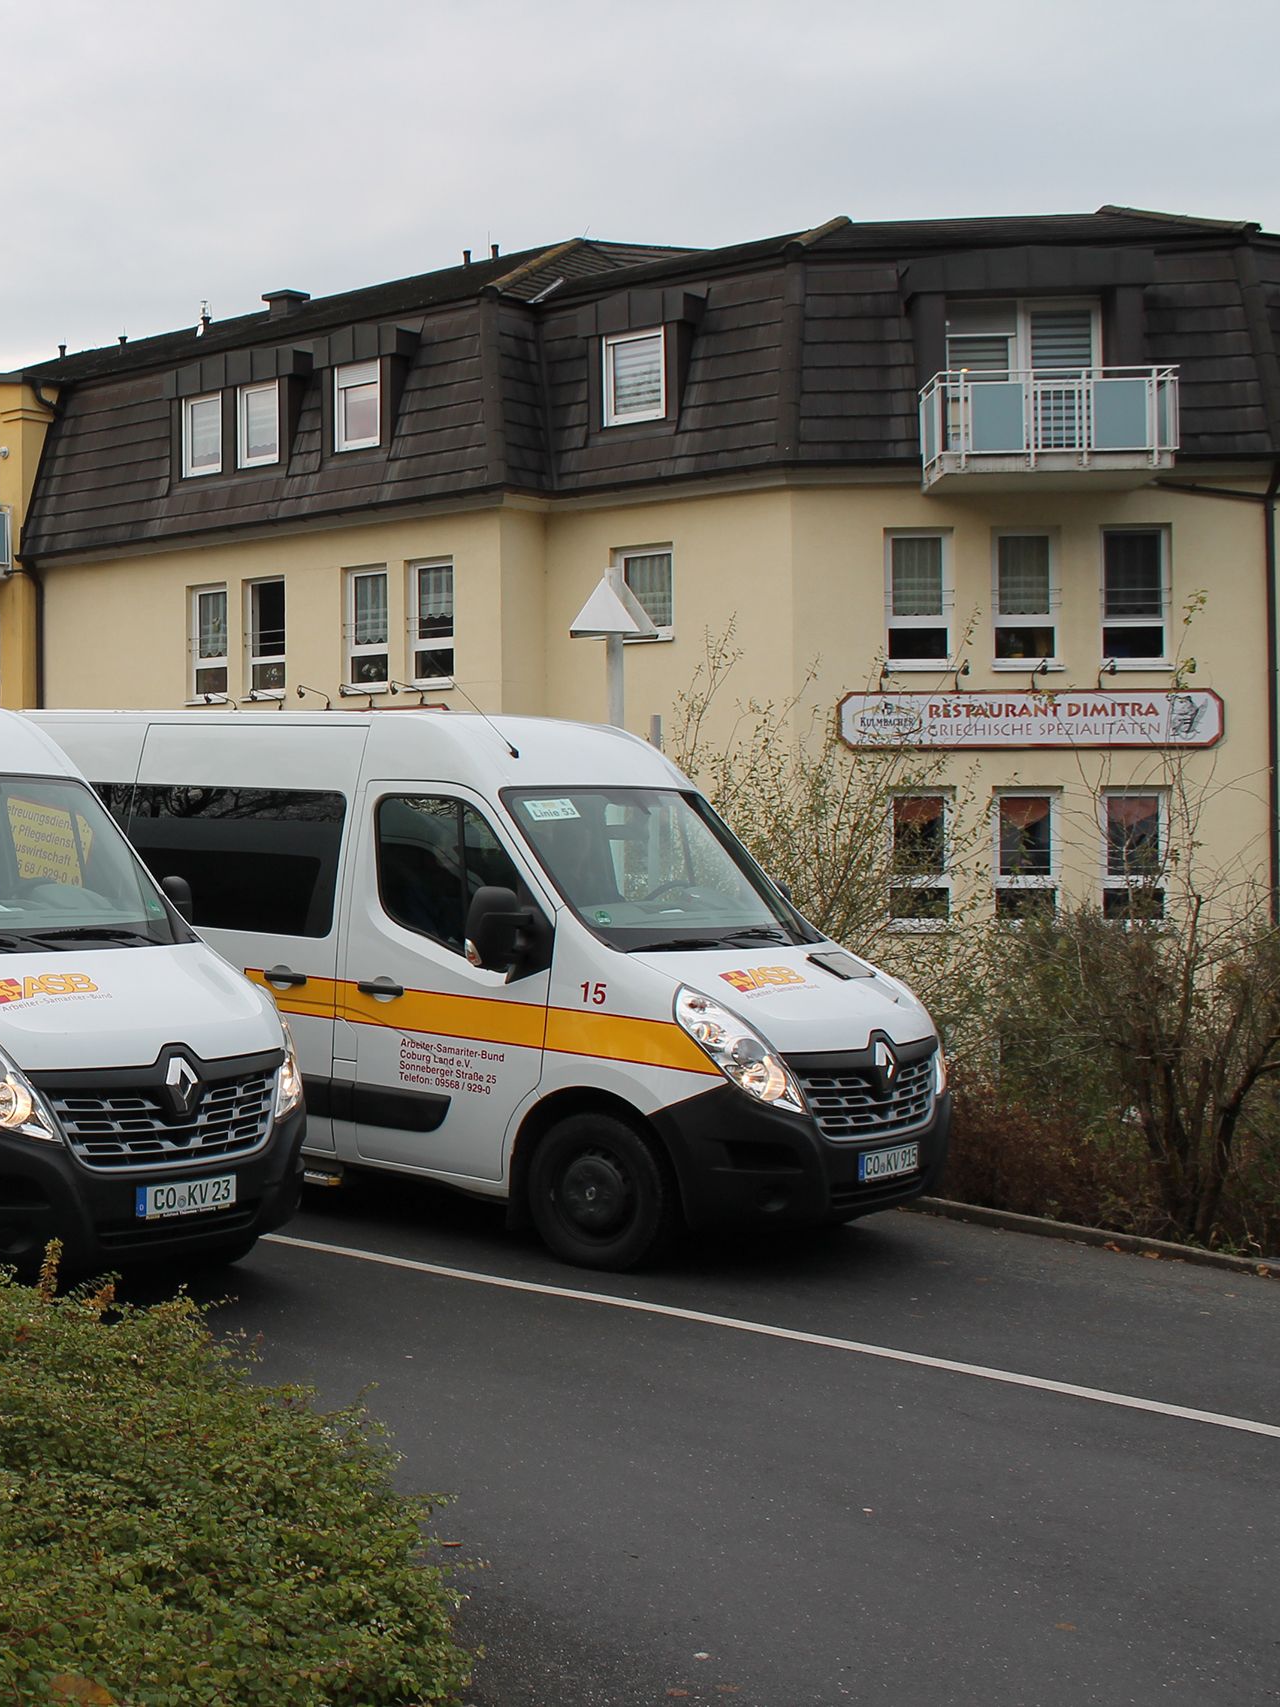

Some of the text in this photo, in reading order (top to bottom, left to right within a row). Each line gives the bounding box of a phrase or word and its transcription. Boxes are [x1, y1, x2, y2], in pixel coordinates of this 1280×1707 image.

[928, 702, 1160, 719] RESTAURANT DIMITRA
[928, 720, 1160, 737] GRIECHISCHE SPEZIALITÄTEN
[561, 807, 576, 816] 53
[19, 824, 74, 848] Pflegedienst
[23, 973, 99, 999] ASB
[747, 966, 806, 988] ASB
[2, 992, 113, 1012] Arbeiter-Samariter-Bund
[580, 981, 607, 1005] 15
[400, 1038, 505, 1063] Arbeiter-Samariter-Bund
[400, 1049, 473, 1069] Coburg Land e.V.
[399, 1072, 433, 1085] Telefon:
[435, 1078, 460, 1090] 09568
[467, 1083, 491, 1095] 929-0
[400, 1060, 497, 1085] Sonneberger Straße 25
[866, 1148, 917, 1175] CO KV 915
[154, 1187, 176, 1210] CO
[187, 1182, 209, 1206] KV
[212, 1179, 231, 1202] 23
